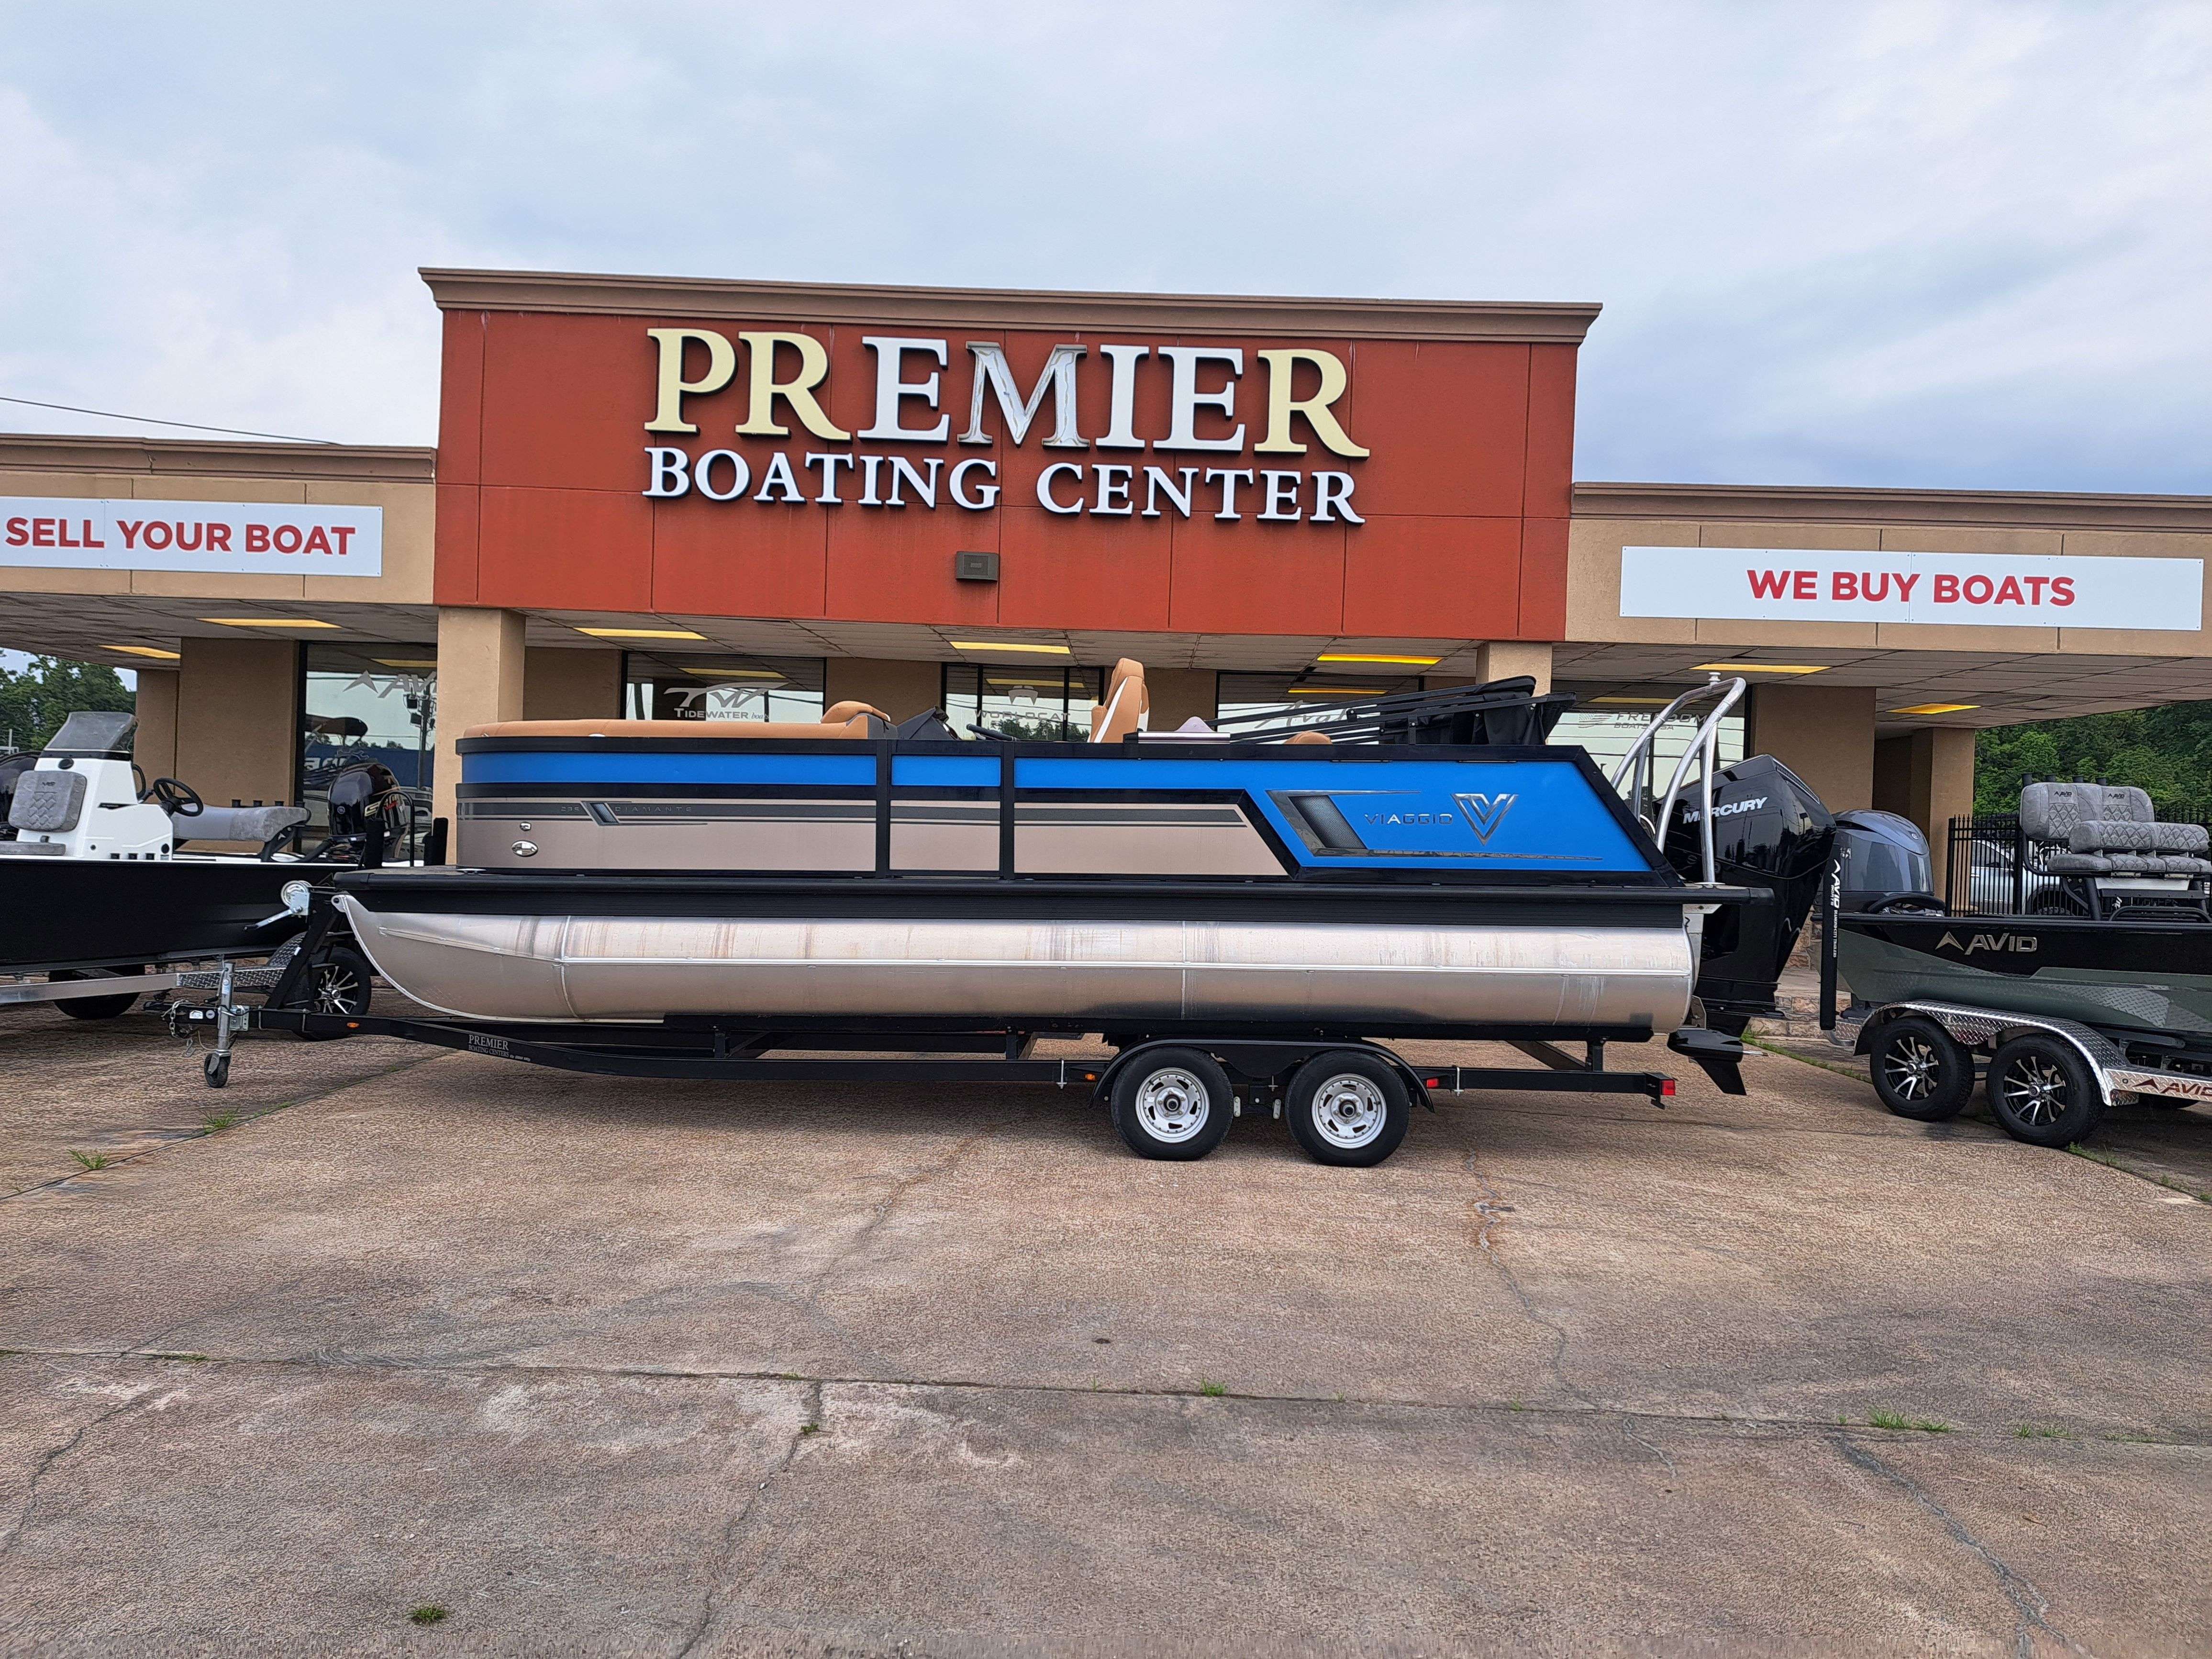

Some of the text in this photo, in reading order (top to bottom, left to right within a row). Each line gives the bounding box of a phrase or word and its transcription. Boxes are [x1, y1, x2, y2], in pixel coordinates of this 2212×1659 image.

[644, 328, 1370, 459] PREMIER
[642, 447, 1366, 525] BOATING CENTER
[5, 517, 356, 556] SELL YOUR BOAT
[1746, 569, 2076, 607] WE BUY BOATS
[1364, 813, 1454, 824] VIAGGIO
[1682, 797, 1768, 824] MRCURY
[1832, 872, 1841, 909] AVID
[1964, 933, 2037, 956] AVID
[468, 1034, 510, 1051] PREMIER
